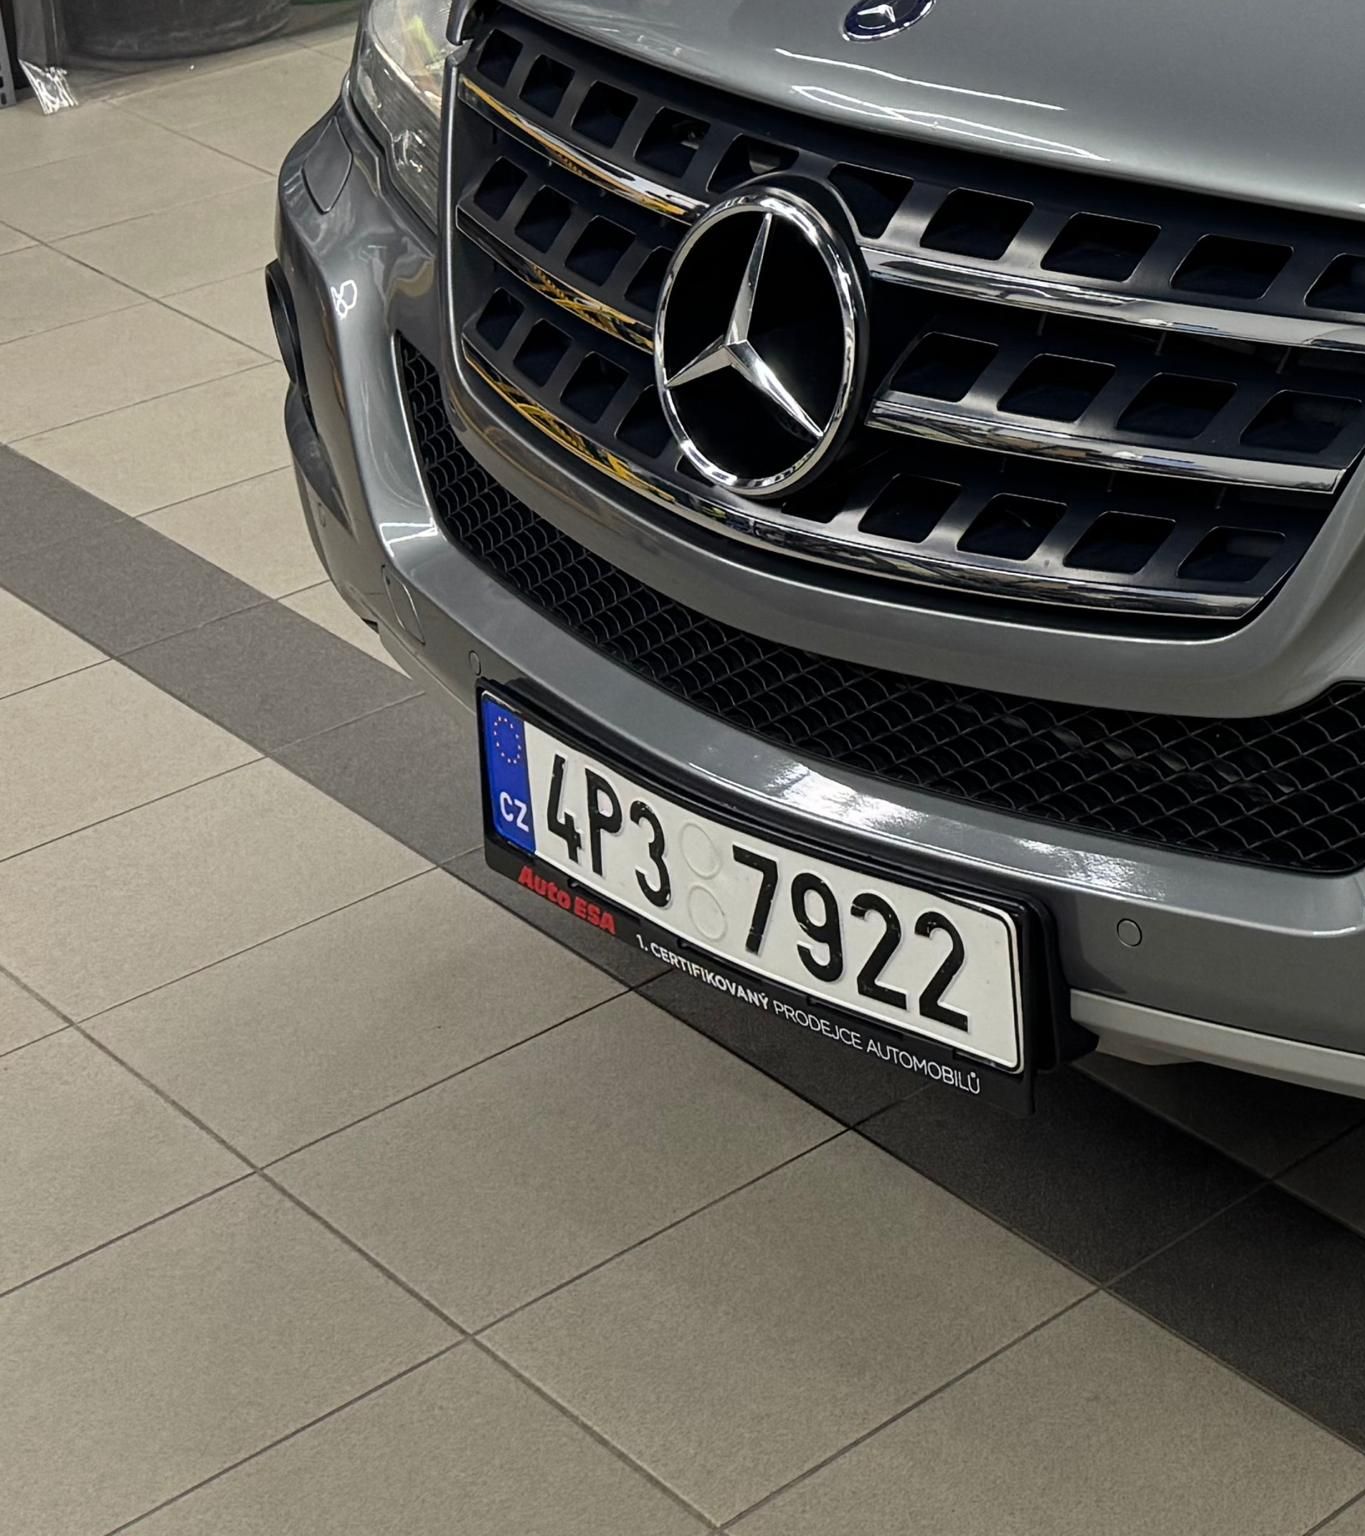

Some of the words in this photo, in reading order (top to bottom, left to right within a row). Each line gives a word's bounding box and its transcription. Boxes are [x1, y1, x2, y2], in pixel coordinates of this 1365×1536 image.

[499, 791, 529, 833] CZ
[518, 865, 572, 910] Auto
[574, 895, 616, 935] ESA
[547, 753, 672, 907] 4P3
[732, 844, 969, 1034] 7922
[635, 933, 649, 952] 1.
[650, 942, 769, 1011] CERTIFIKOVANÝ
[773, 999, 864, 1051] PRODEJCE
[866, 1038, 981, 1095] AUTOMOBILŮ
